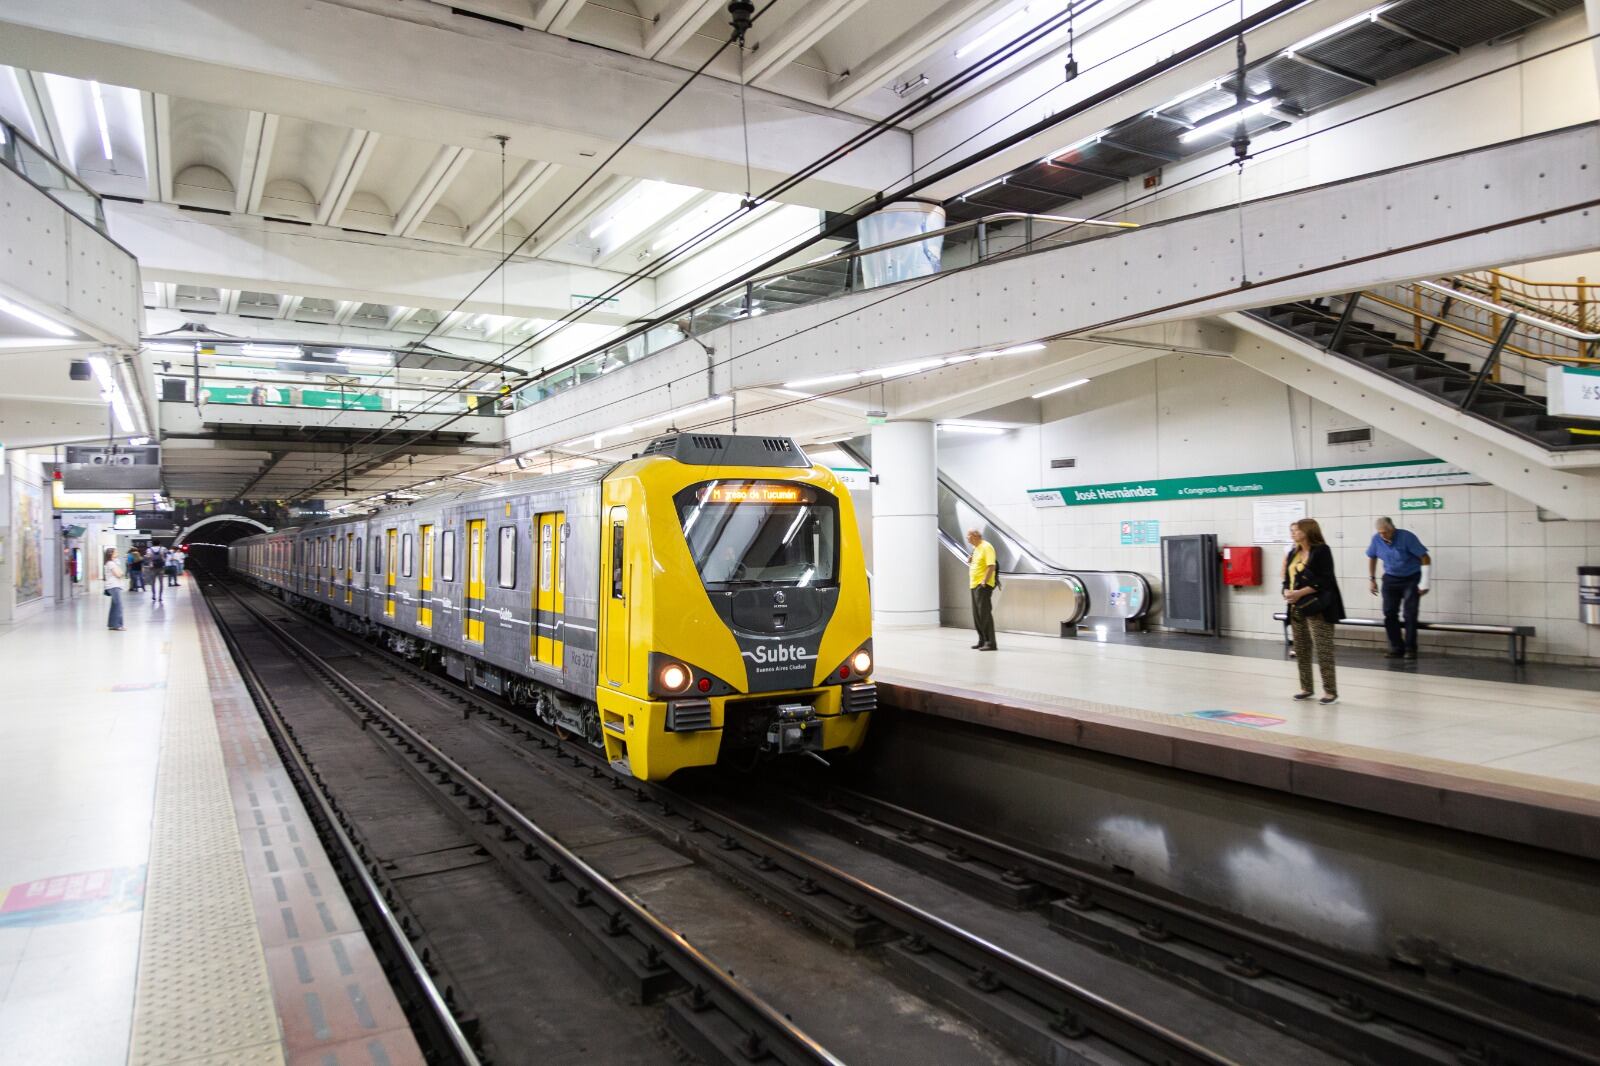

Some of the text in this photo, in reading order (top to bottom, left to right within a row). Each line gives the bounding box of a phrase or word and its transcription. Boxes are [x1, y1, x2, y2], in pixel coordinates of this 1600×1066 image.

[750, 490, 760, 499] de
[763, 489, 797, 500] Tucumán
[1074, 486, 1159, 501] José Hernández
[1183, 486, 1217, 496] Congreso
[1218, 485, 1228, 493] de
[1228, 483, 1264, 493] Tucumán
[755, 643, 807, 664] Subte
